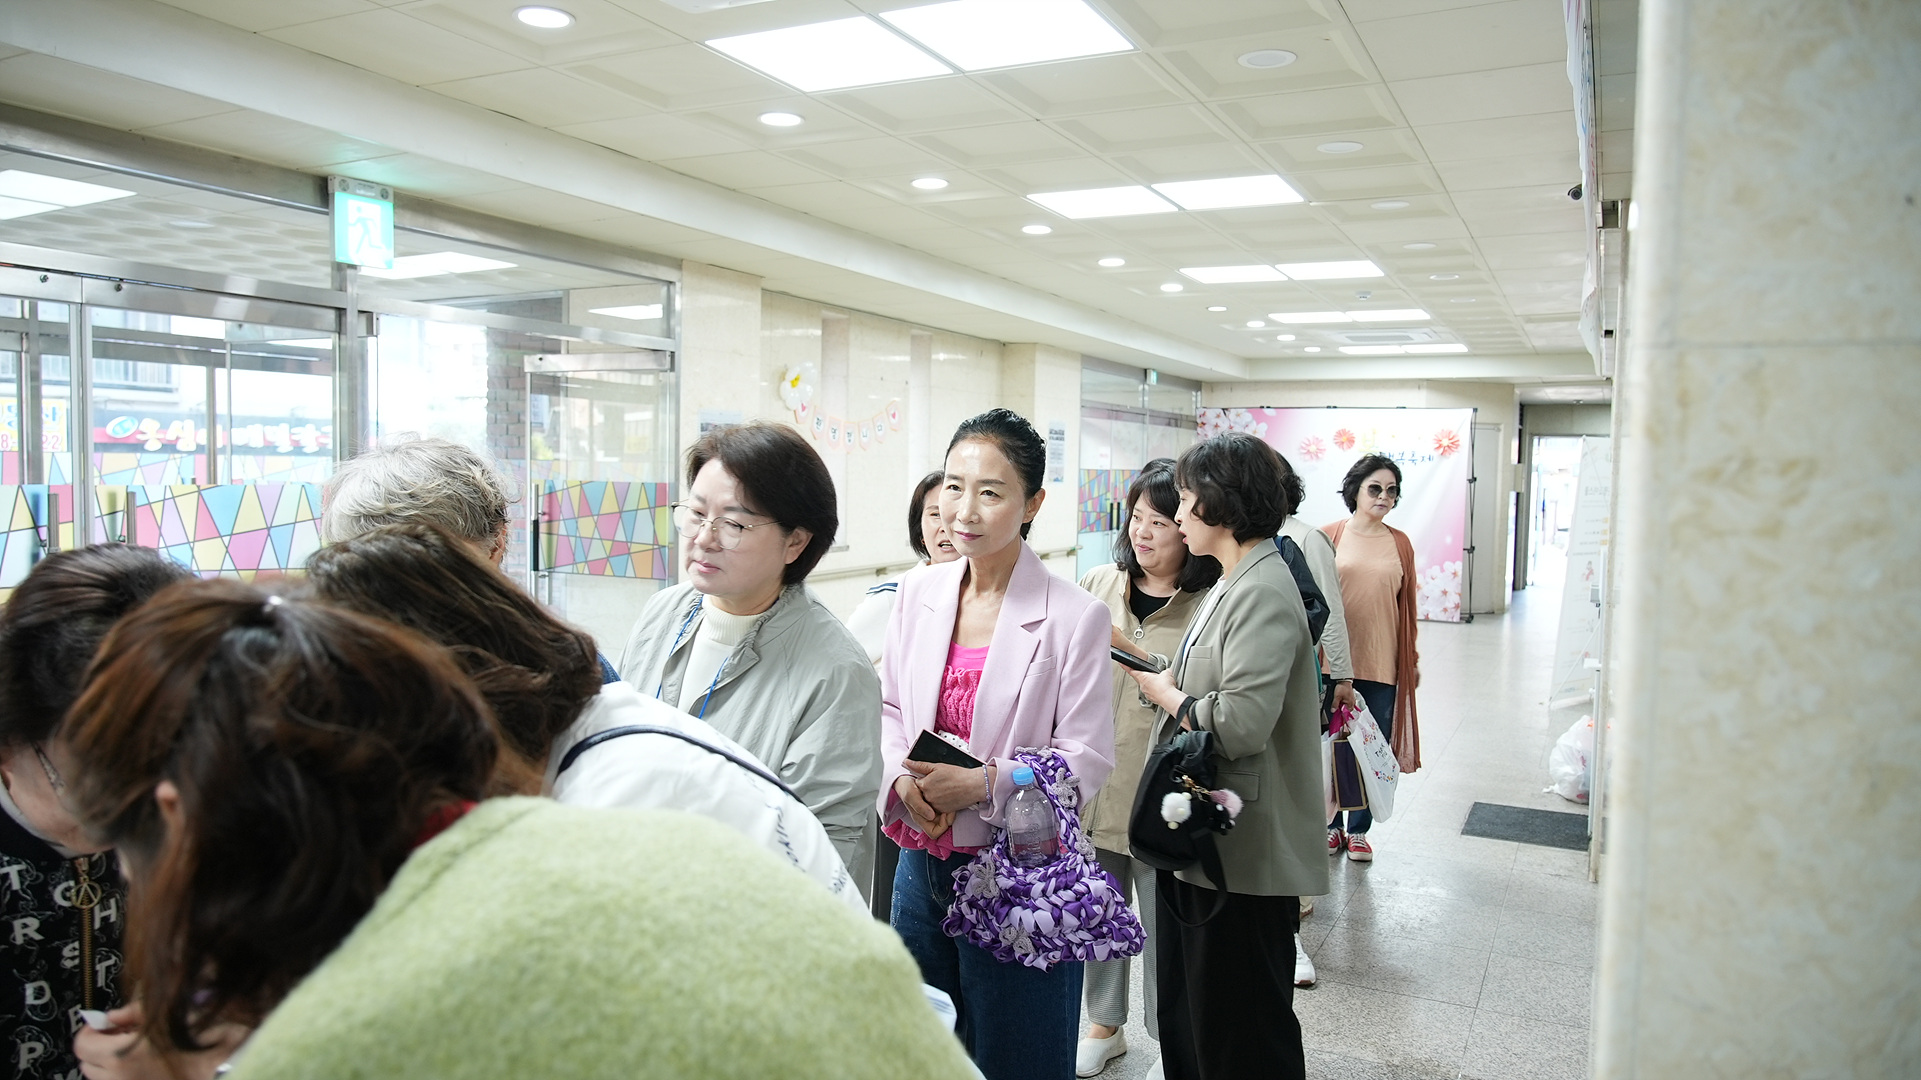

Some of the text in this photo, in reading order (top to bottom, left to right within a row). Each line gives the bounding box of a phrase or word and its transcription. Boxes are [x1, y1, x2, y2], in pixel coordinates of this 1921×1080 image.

[0, 864, 27, 891] T
[94, 897, 117, 930] H
[12, 917, 44, 945] R
[25, 981, 51, 1005] D
[18, 1041, 46, 1070] P
